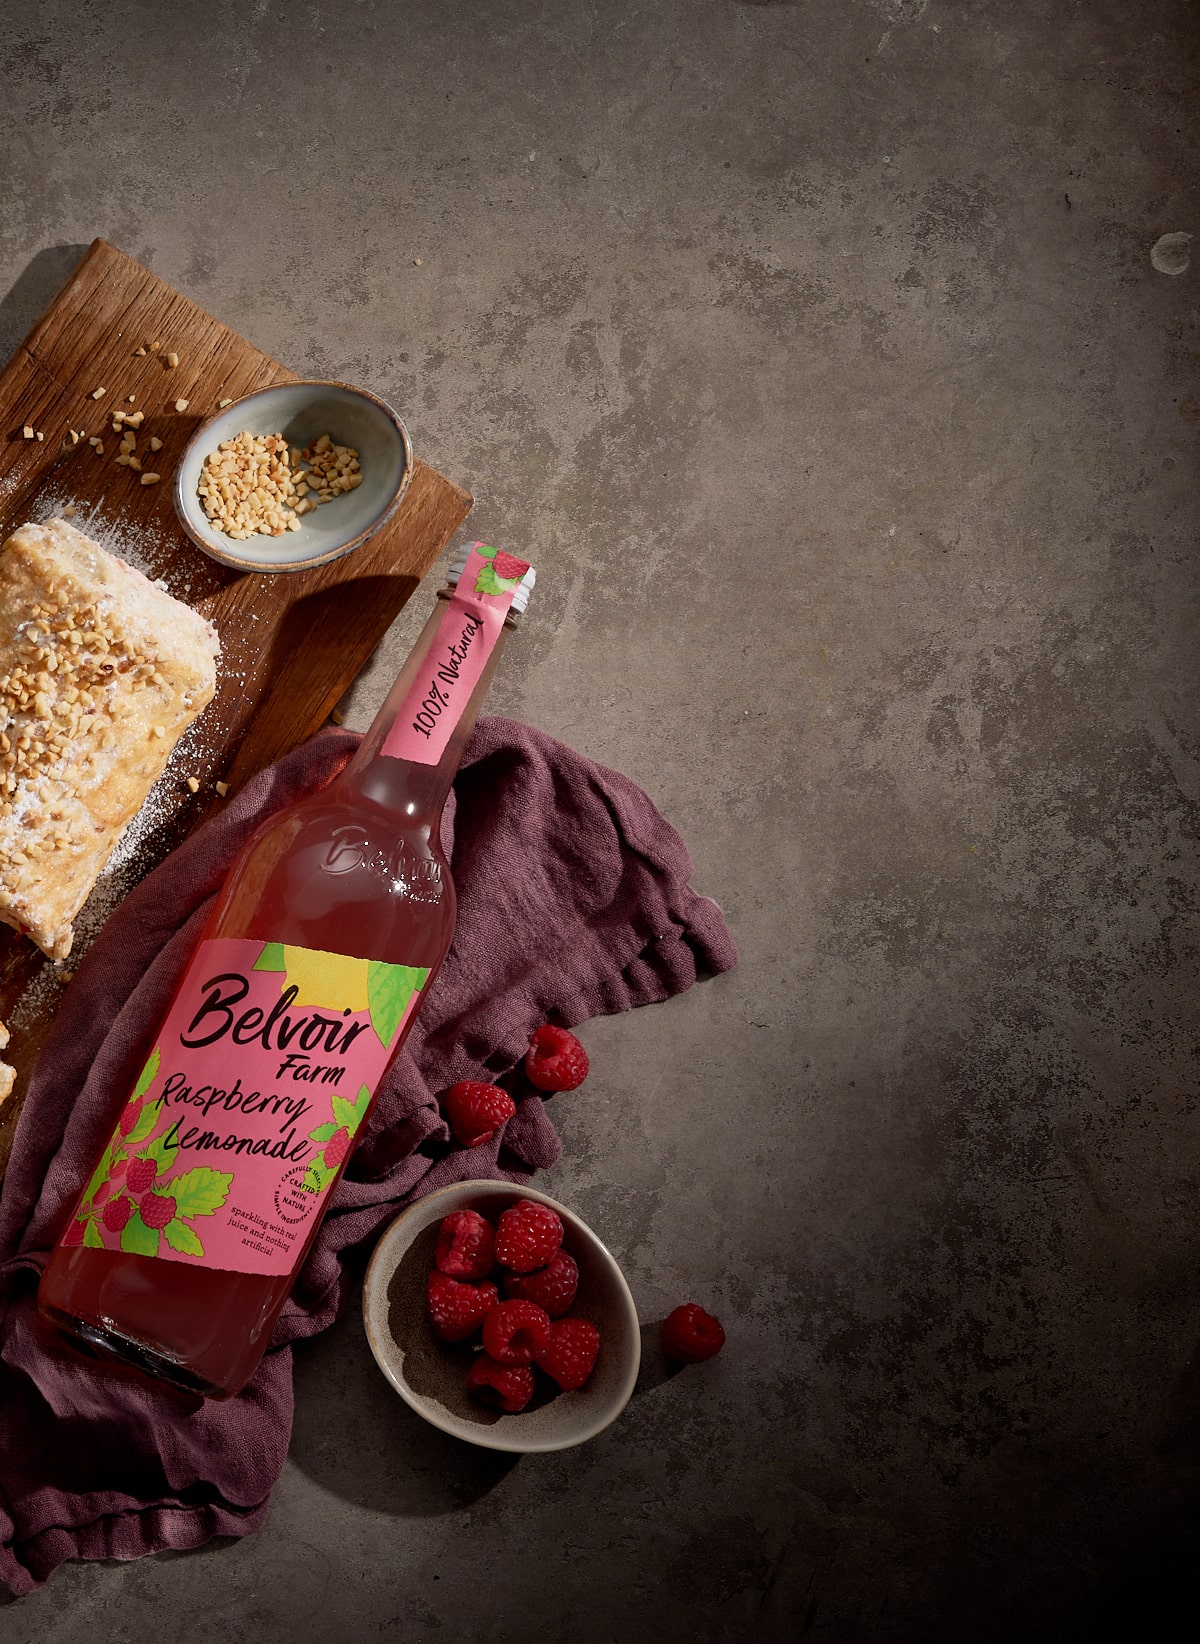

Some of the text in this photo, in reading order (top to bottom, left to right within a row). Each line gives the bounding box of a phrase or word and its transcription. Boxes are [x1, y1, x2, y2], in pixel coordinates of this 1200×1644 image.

[411, 612, 484, 740] 100% Natural
[180, 973, 370, 1055] Belvoir
[276, 1053, 346, 1087] Farm
[155, 1072, 313, 1133] Raspberry
[163, 1121, 313, 1162] Lemonade
[281, 1165, 313, 1182] CAREFULLY
[289, 1178, 315, 1194] CRAFTED
[274, 1190, 283, 1215] SIMPLE
[282, 1196, 306, 1212] NATURE
[291, 1189, 307, 1202] WITH
[226, 1216, 291, 1253] juice and nothing
[230, 1206, 298, 1241] sparkling with real
[241, 1237, 274, 1256] artificial
